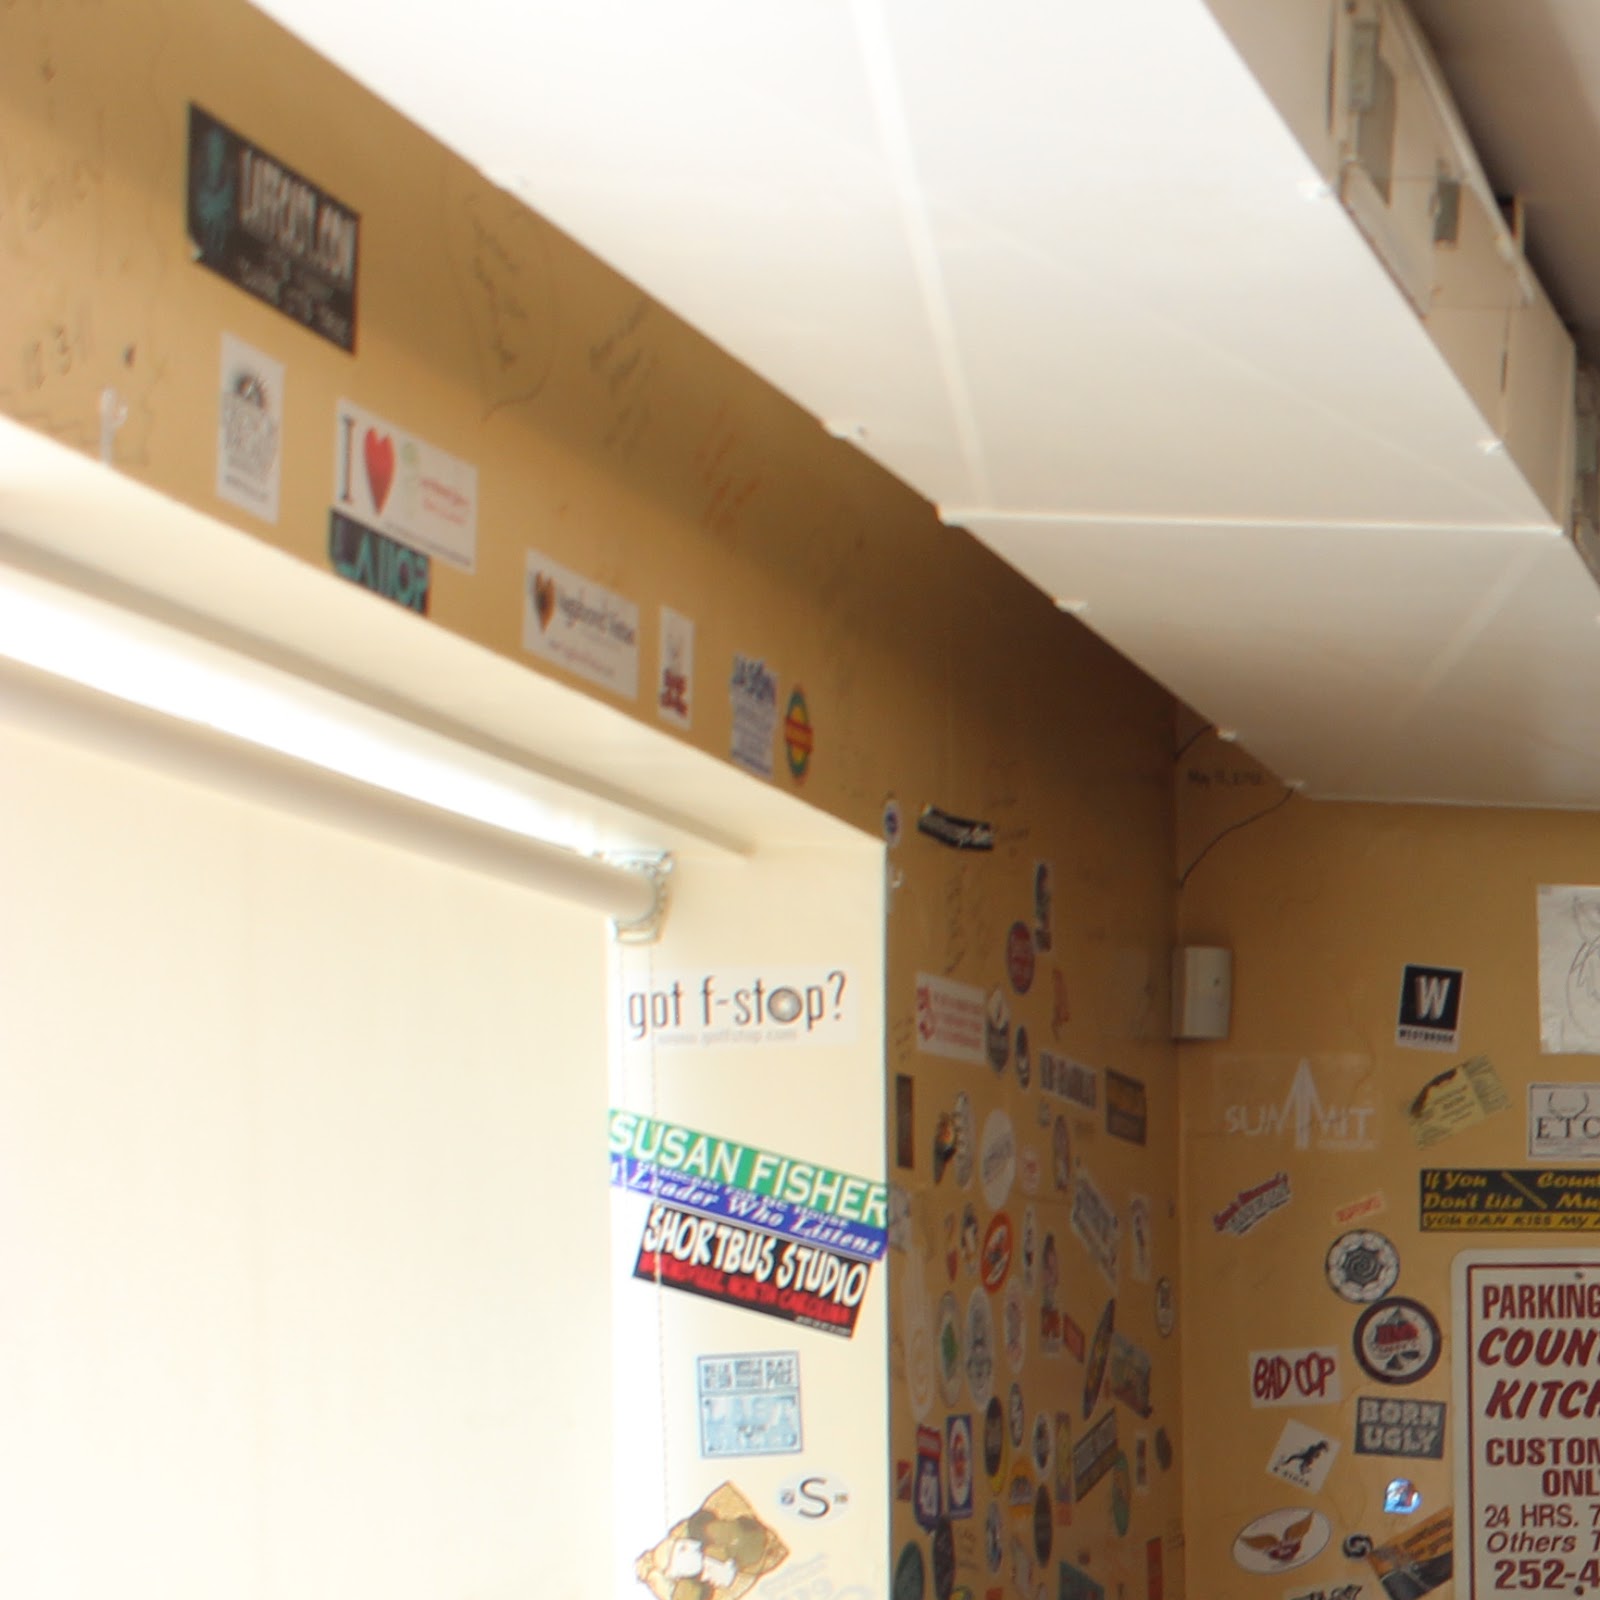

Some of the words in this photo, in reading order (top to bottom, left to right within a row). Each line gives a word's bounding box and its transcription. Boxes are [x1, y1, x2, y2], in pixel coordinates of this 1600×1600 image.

[627, 980, 683, 1041] got
[1416, 975, 1450, 1020] W
[609, 1111, 744, 1183] SUSAN
[749, 1150, 887, 1229] FISHER
[1444, 1172, 1488, 1188] You
[628, 1169, 721, 1208] Leader
[726, 1194, 787, 1228] Who
[789, 1213, 882, 1256] Listens
[1424, 1193, 1478, 1210] Don't
[642, 1206, 777, 1284] SHORTBUS
[776, 1242, 869, 1307] STUDIO
[1252, 1354, 1292, 1401] BAD
[1293, 1351, 1337, 1398] COP
[1359, 1400, 1442, 1429] BORN
[1361, 1426, 1438, 1454] UGLY
[1484, 1505, 1511, 1529] 24
[1519, 1504, 1580, 1528] HRS.
[1485, 1530, 1577, 1555] Others
